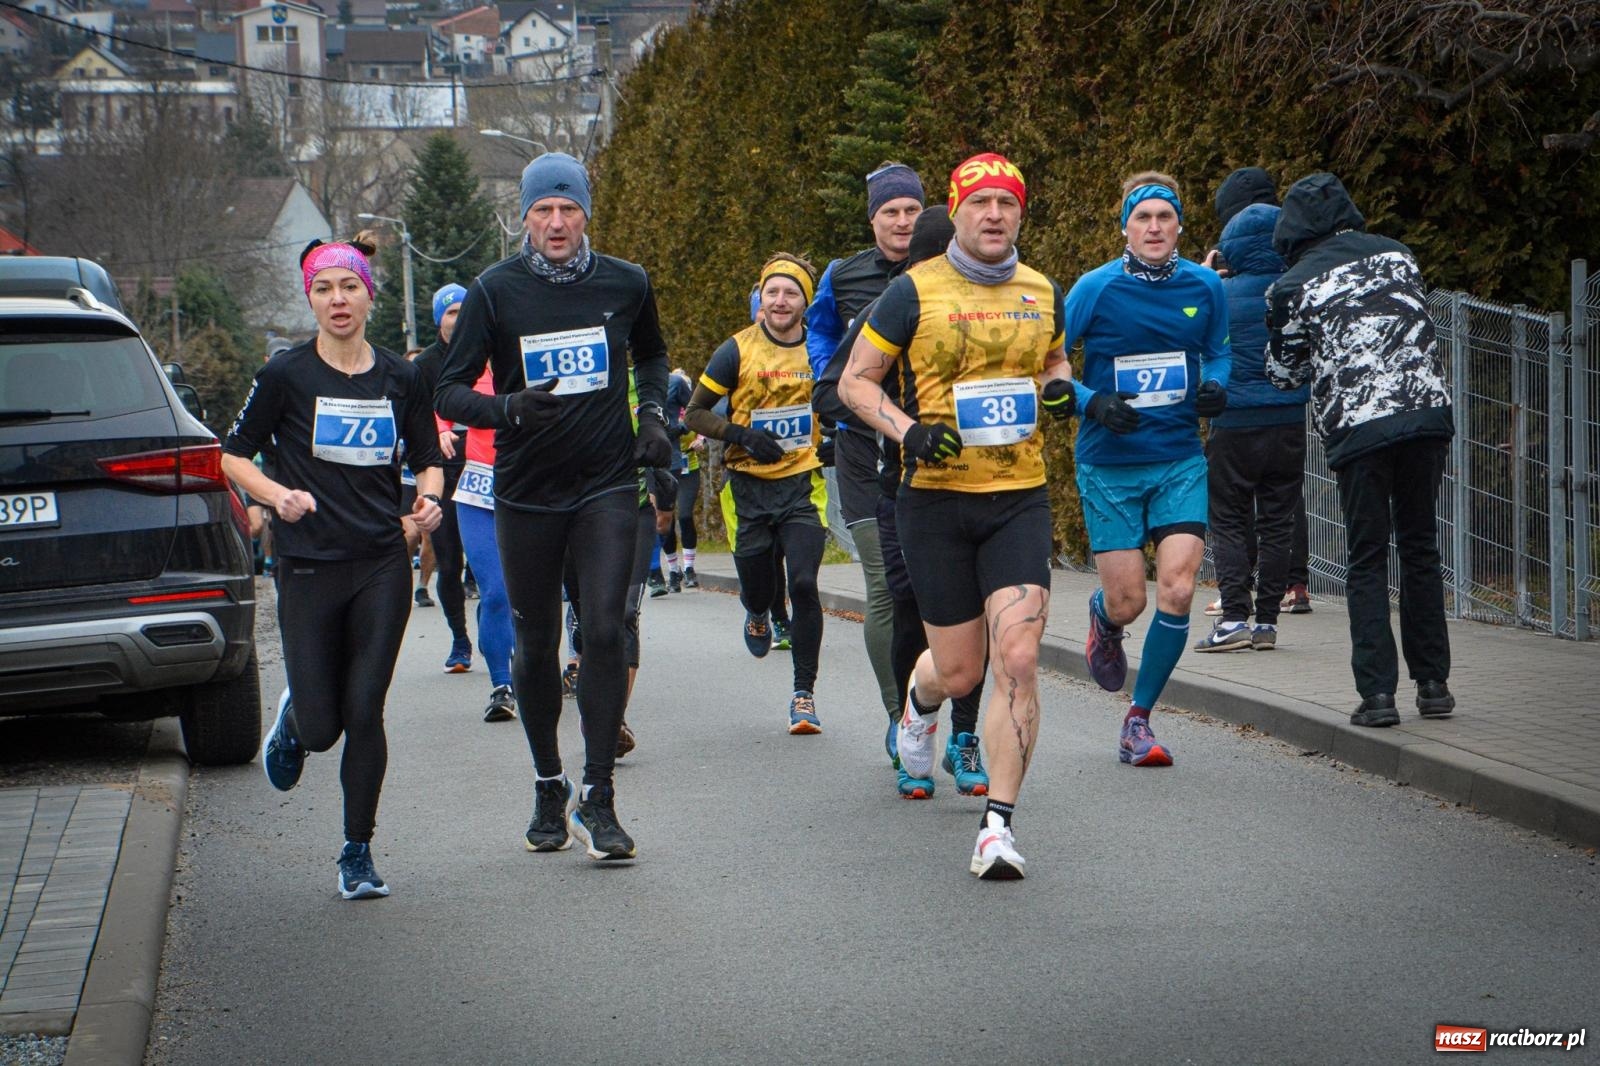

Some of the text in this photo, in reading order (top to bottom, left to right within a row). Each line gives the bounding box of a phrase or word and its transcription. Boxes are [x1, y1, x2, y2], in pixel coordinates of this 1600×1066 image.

[539, 346, 595, 377] 188
[1136, 367, 1167, 391] 97
[982, 396, 1017, 425] 38
[341, 417, 377, 446] 76
[763, 417, 802, 438] 101
[461, 472, 492, 495] 138
